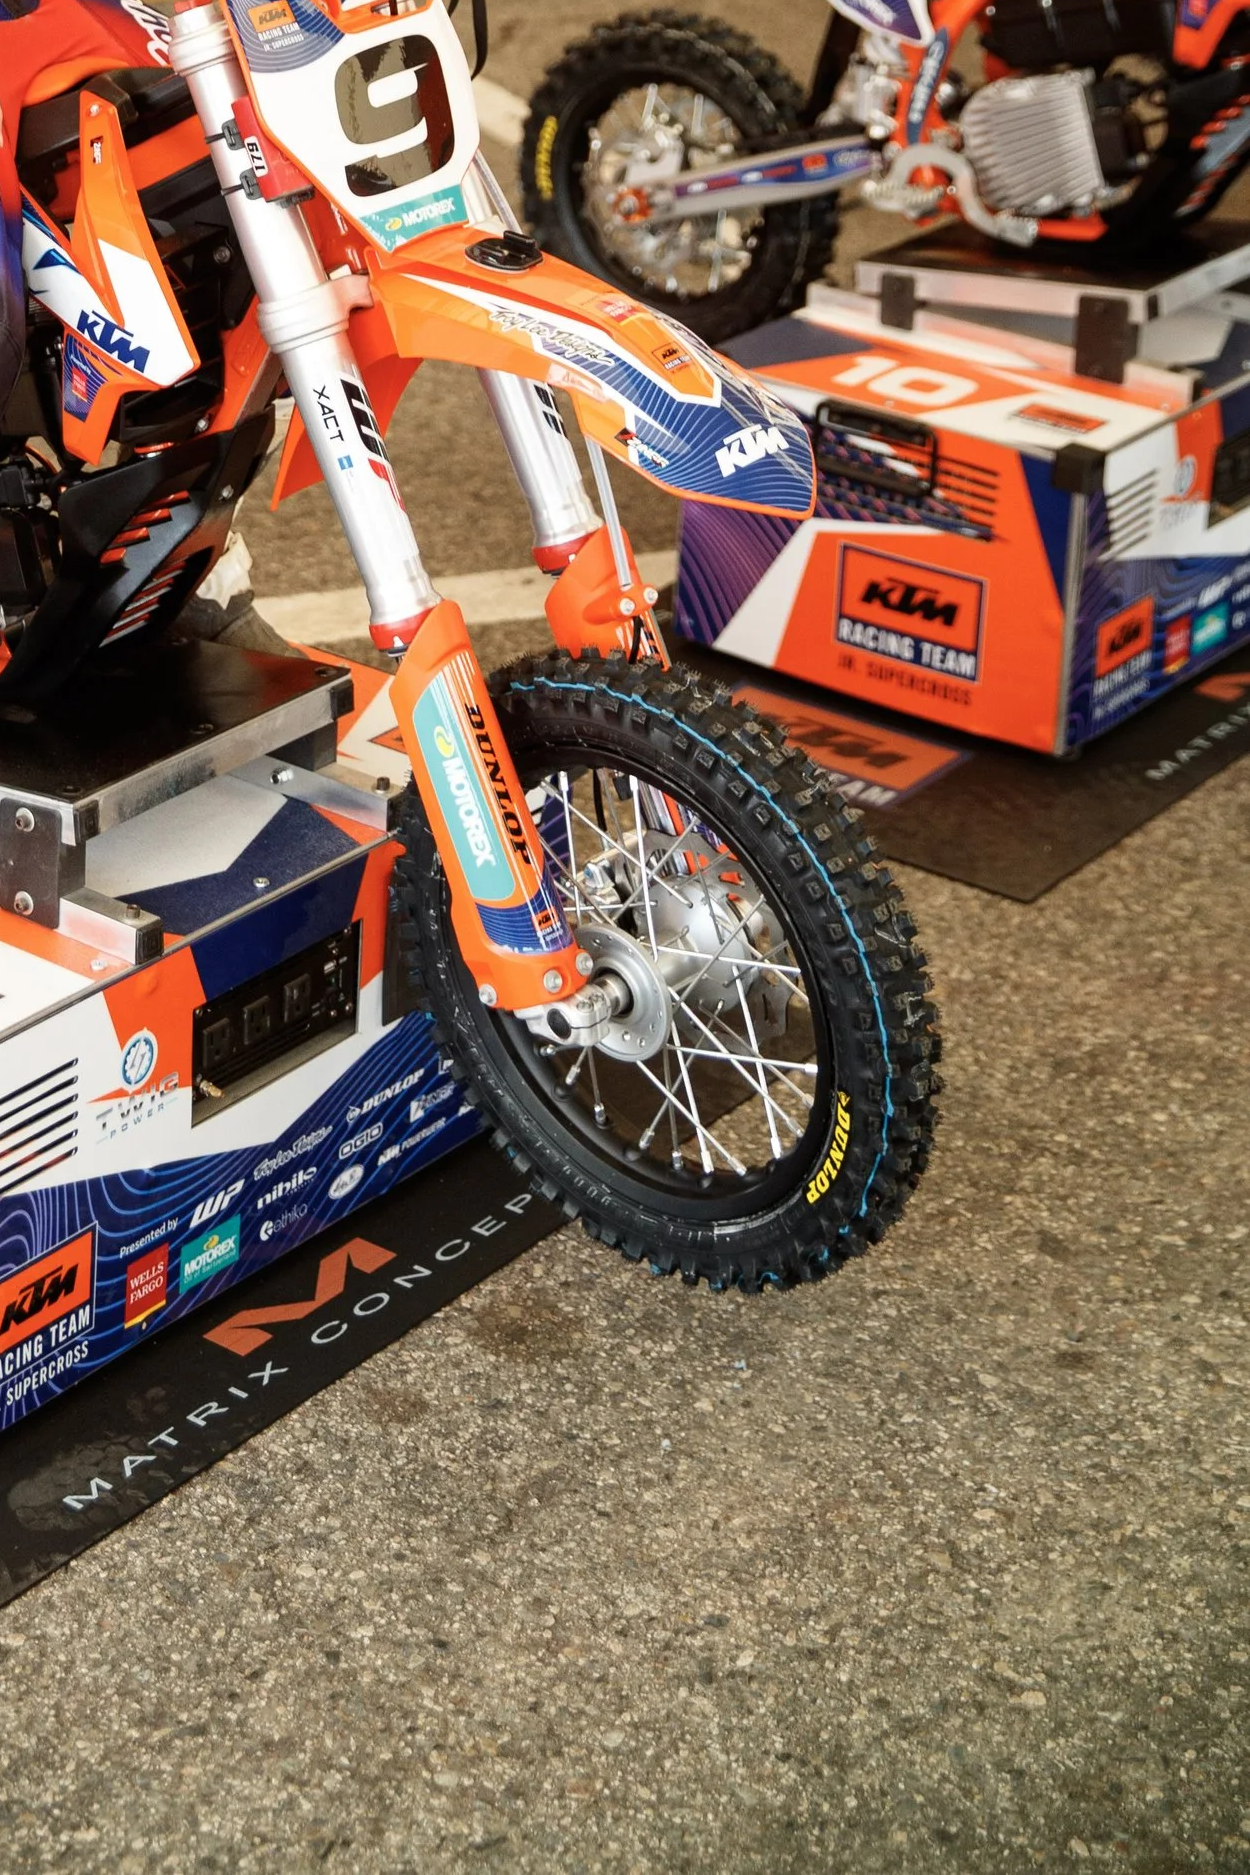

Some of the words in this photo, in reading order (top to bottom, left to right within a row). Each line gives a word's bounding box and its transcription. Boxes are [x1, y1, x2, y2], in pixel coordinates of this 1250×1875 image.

[334, 34, 455, 197] 9
[402, 197, 455, 227] MOTOREX
[76, 309, 150, 374] KTM
[831, 356, 979, 406] 10
[313, 385, 344, 442] XACT
[714, 424, 790, 477] KTM
[861, 577, 958, 628] KTM
[838, 617, 915, 660] RACING
[919, 641, 977, 677] TEAM
[465, 702, 532, 865] DUNLOP
[442, 756, 497, 868] MOTOREX
[95, 1071, 180, 1131] TWIG
[361, 1069, 425, 1115] DUNLOP
[110, 1103, 165, 1139] POWER
[338, 1122, 383, 1160] OGIO
[806, 1101, 851, 1204] DUNLOP
[189, 1178, 246, 1229] WP
[256, 1167, 317, 1209] nihilo
[119, 1221, 166, 1259] Presented
[167, 1217, 179, 1233] by
[272, 1202, 309, 1232] ethika
[129, 1261, 164, 1290] WELLS
[184, 1234, 238, 1276] MOTOREX
[129, 1276, 164, 1305] FARGO
[49, 1306, 91, 1355] TEAM
[62, 1360, 289, 1511] MATRIX
[310, 1193, 533, 1345] CONCEP
[6, 1341, 90, 1412] SUPERCROSS
